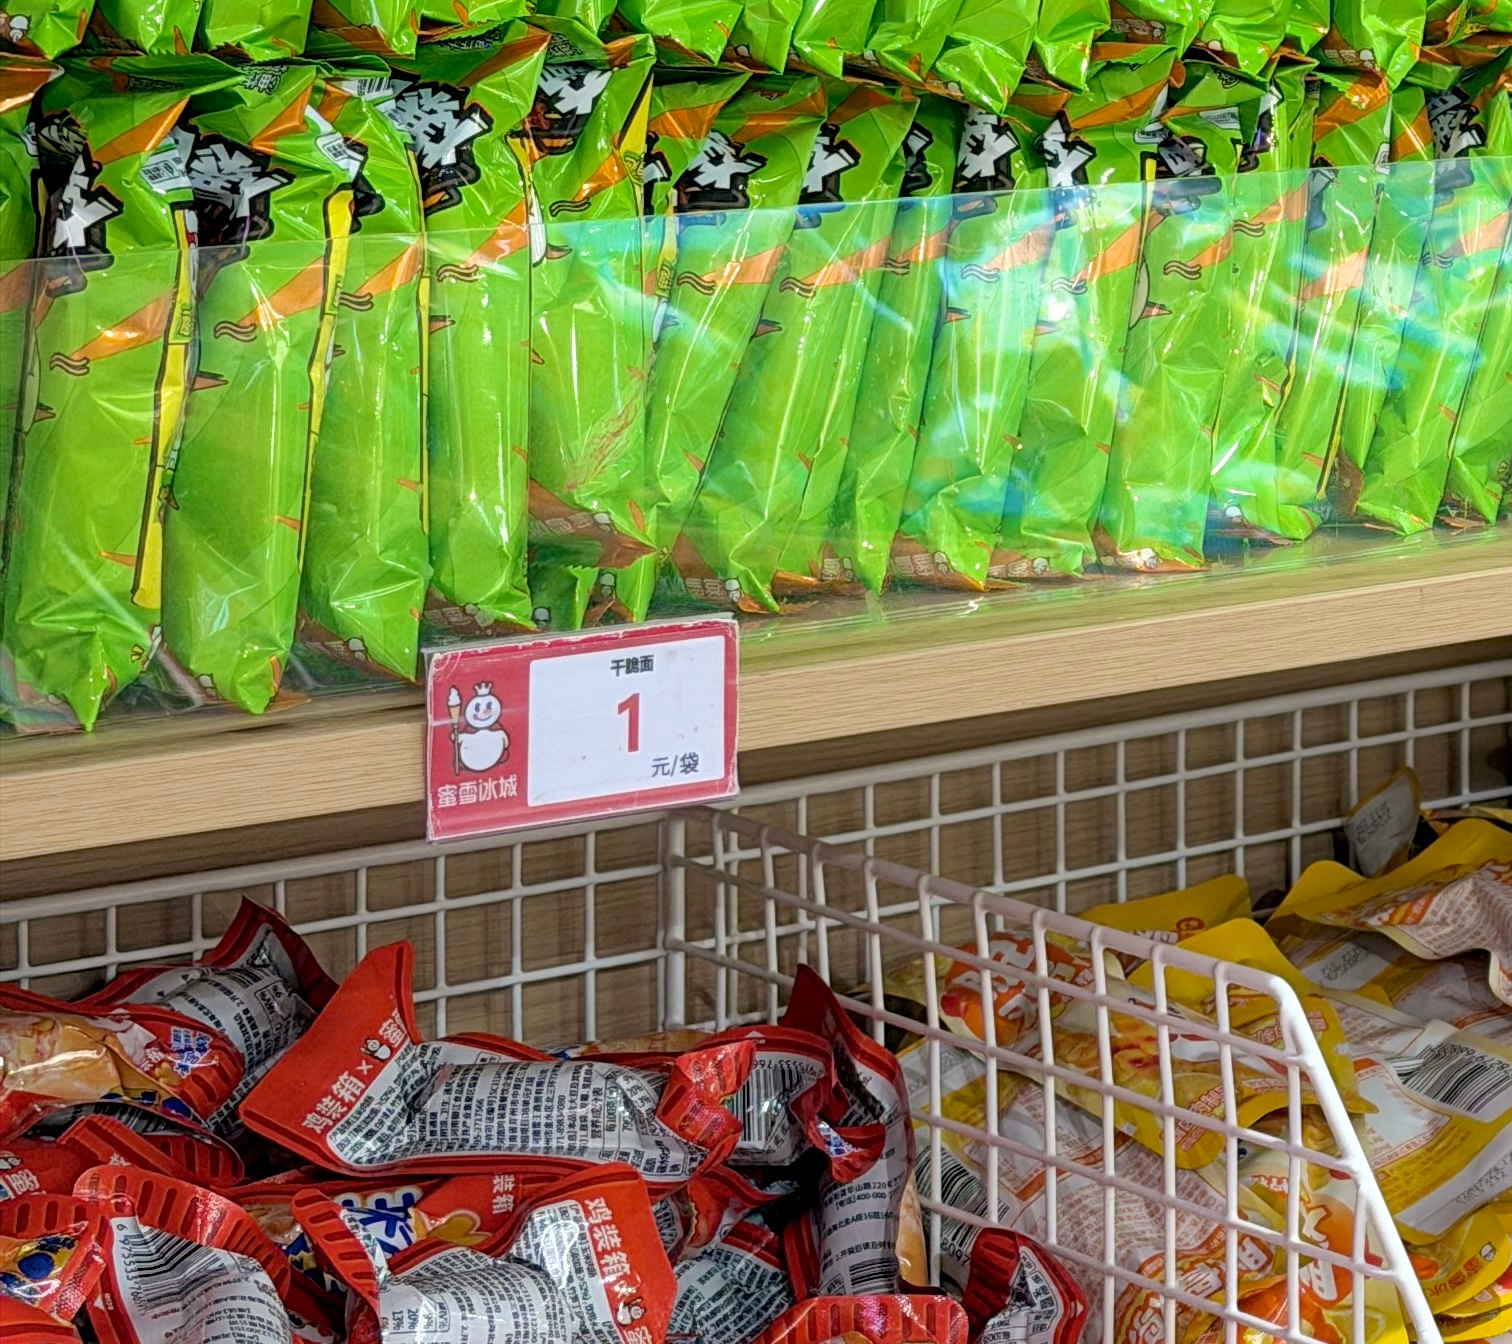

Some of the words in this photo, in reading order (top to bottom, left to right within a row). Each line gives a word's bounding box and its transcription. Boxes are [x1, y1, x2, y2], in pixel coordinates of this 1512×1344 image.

[610, 654, 655, 678] 干脆面
[617, 692, 641, 753] 1
[651, 753, 700, 778] 元/袋
[437, 774, 519, 809] 蜜雪冰城
[392, 1309, 404, 1331] 13%
[408, 1308, 419, 1330] 20%
